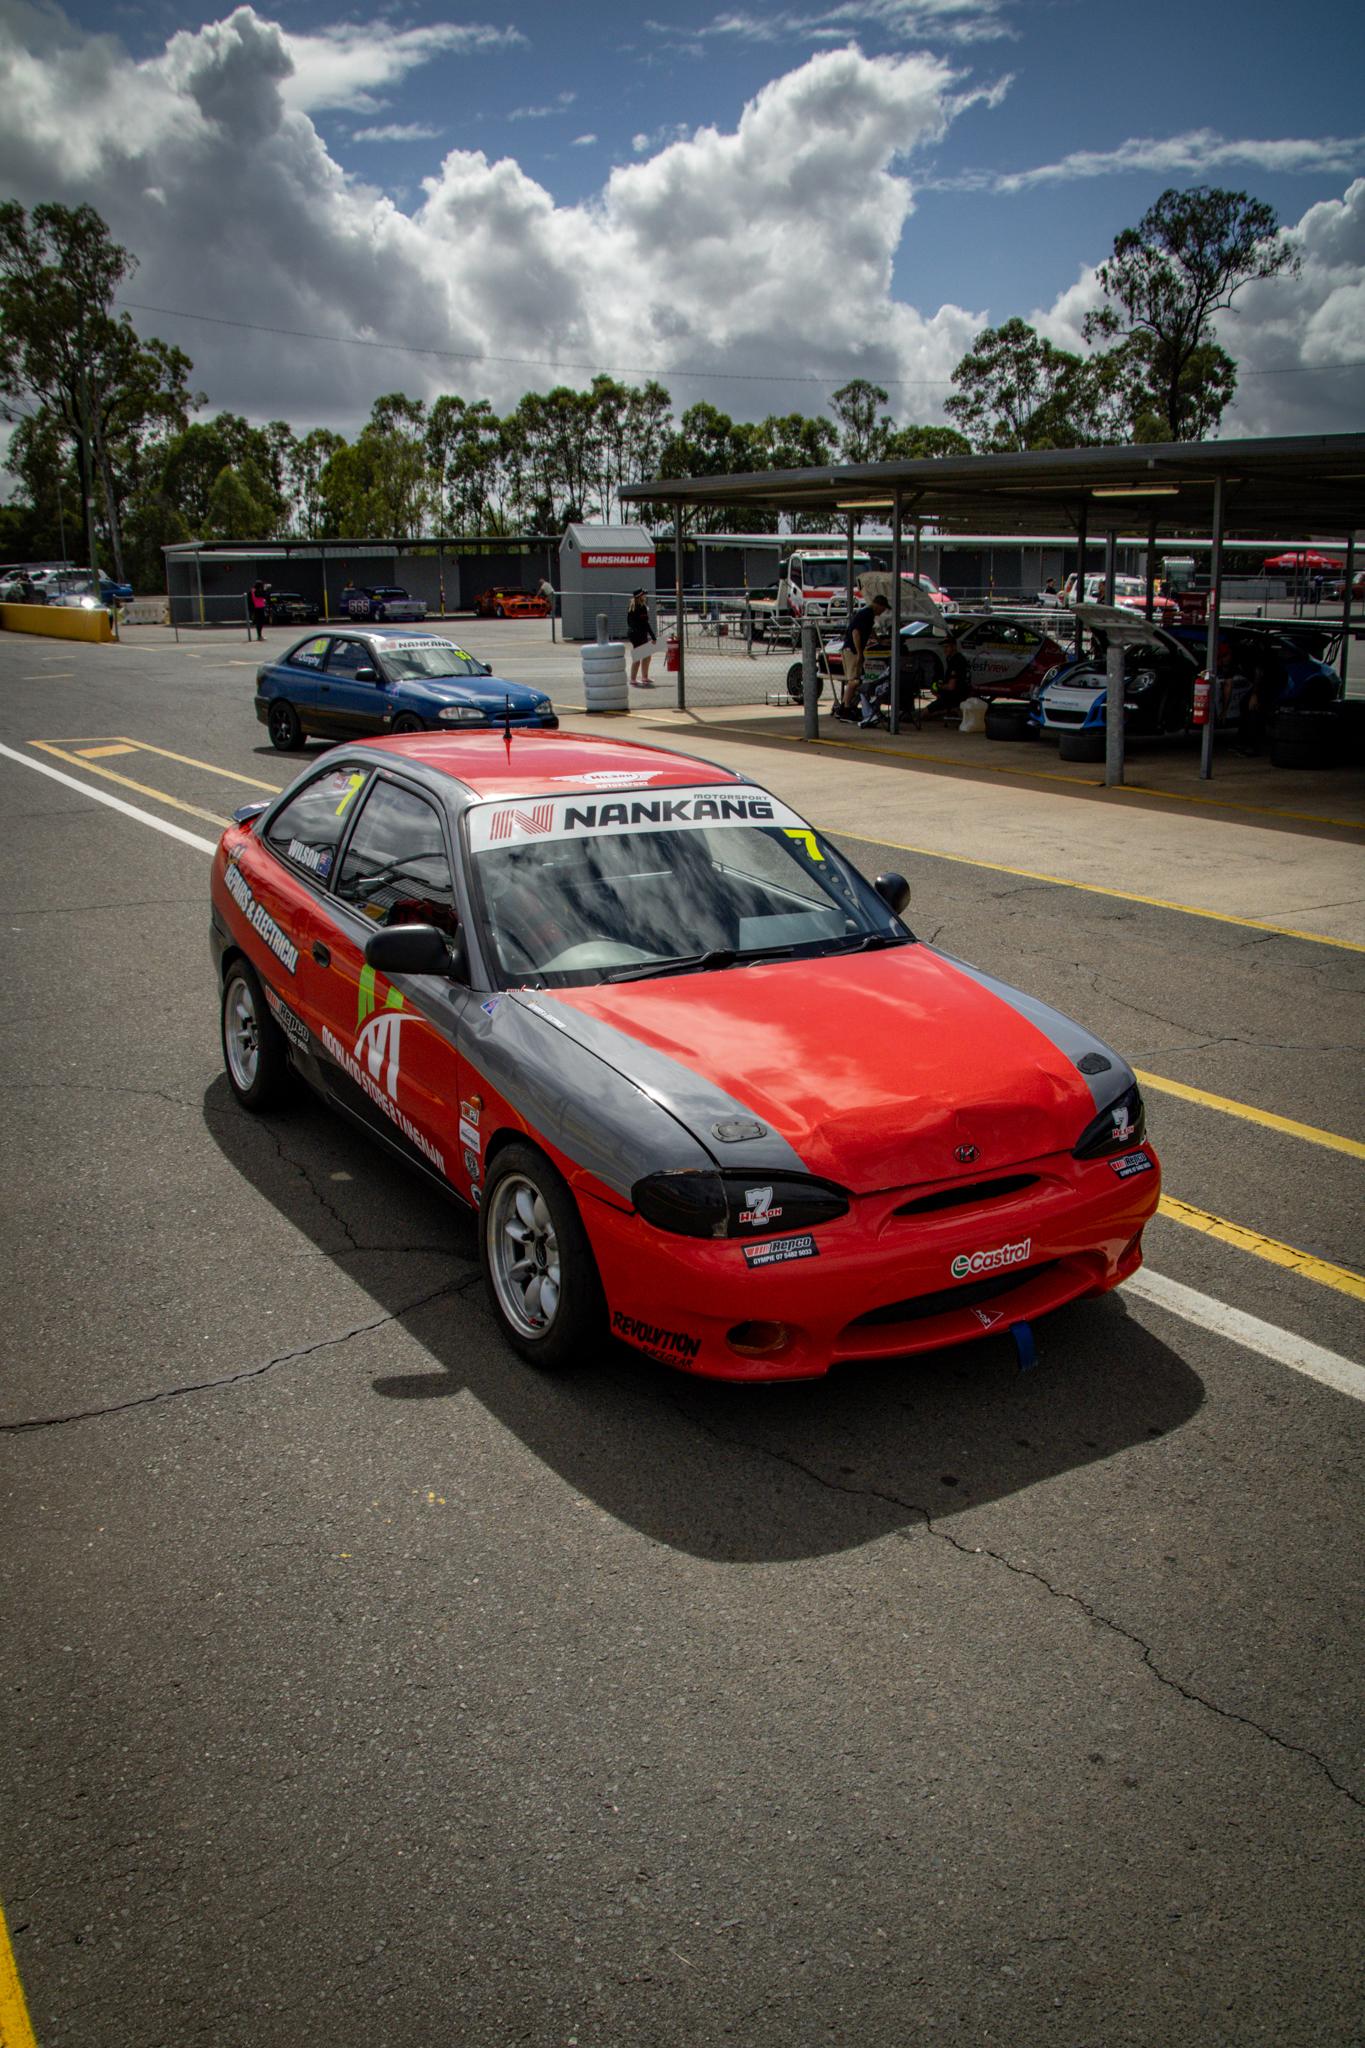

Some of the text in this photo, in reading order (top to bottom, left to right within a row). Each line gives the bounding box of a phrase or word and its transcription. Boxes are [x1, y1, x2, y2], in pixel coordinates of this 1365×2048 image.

[588, 555, 650, 564] MARSHALLING
[399, 640, 452, 648] NANKANG
[335, 773, 365, 816] 7
[564, 800, 775, 831] NANKANG
[288, 838, 320, 870] WILSON
[783, 828, 825, 862] 7
[224, 864, 253, 912] REPAIRS
[246, 900, 256, 922] &
[252, 904, 299, 974] ELECTRICAL
[280, 1000, 310, 1042] Repco
[361, 1072, 391, 1117] STORE
[1112, 1107, 1128, 1141] 7
[1125, 1152, 1148, 1166] Repco
[745, 1186, 773, 1226] 7
[753, 1254, 775, 1265] GYMPIE
[770, 1236, 812, 1252] Repco
[969, 1238, 1031, 1273] Castrol
[613, 1311, 702, 1358] REVOLUTION
